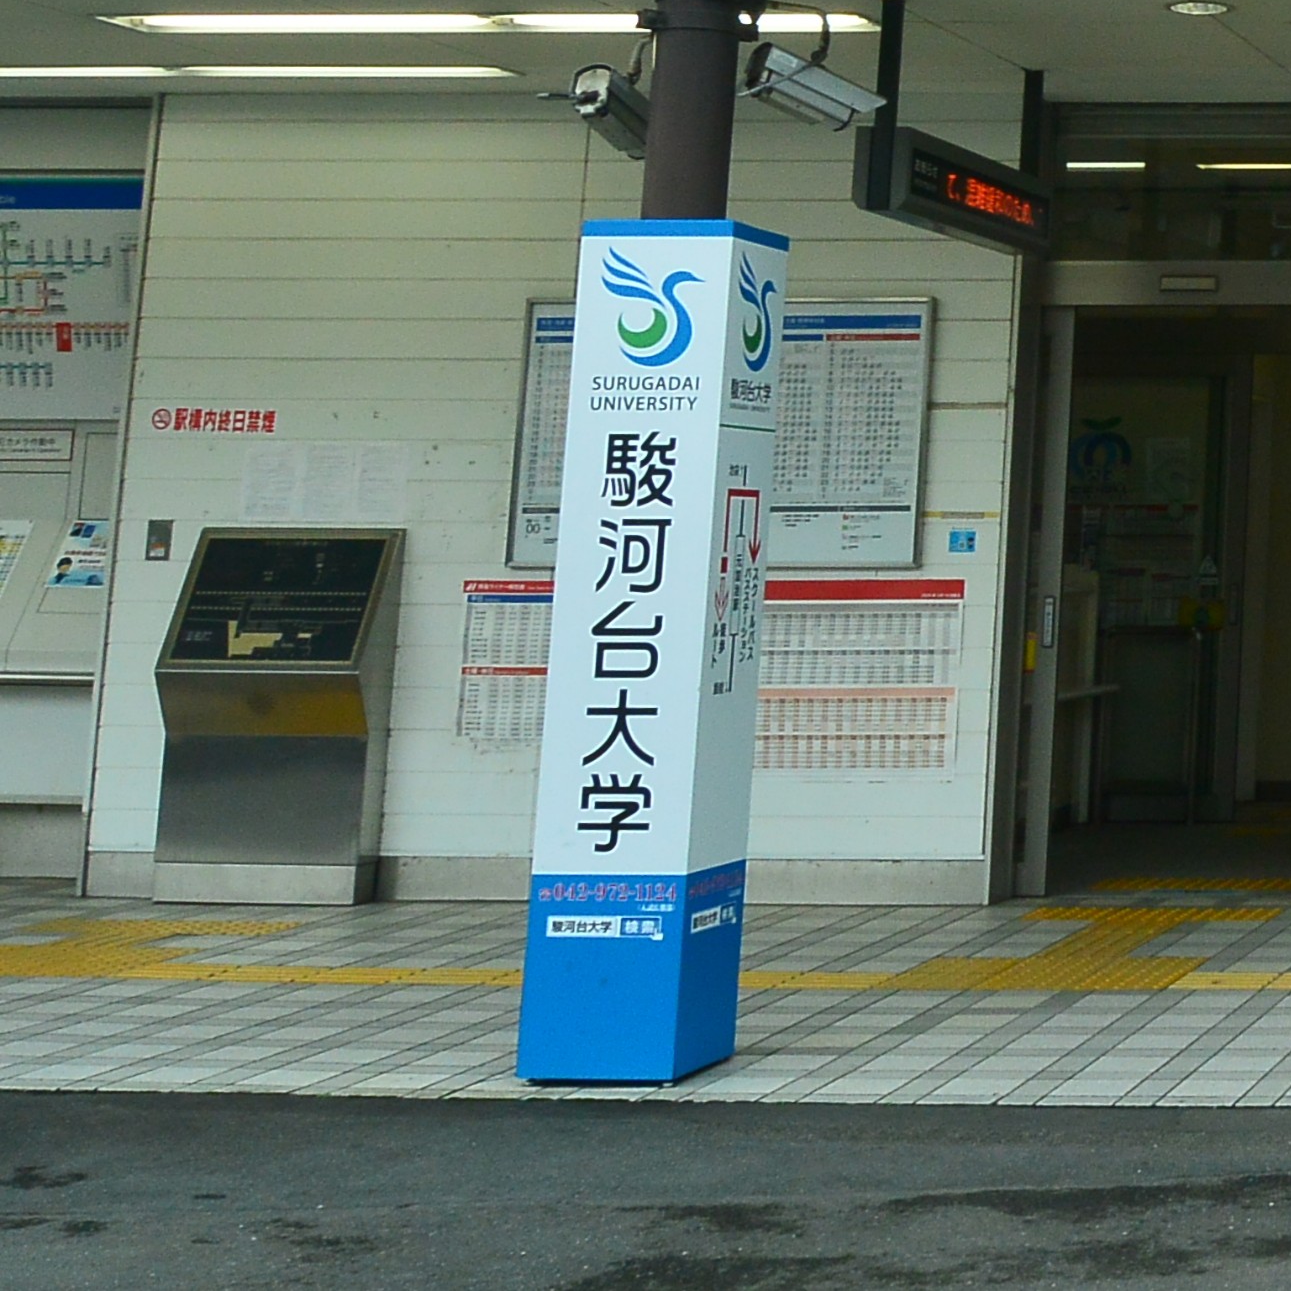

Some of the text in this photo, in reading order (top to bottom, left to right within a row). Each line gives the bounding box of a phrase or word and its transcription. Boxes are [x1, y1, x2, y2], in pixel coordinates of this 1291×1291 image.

[591, 376, 701, 391] SURUGADAI
[589, 396, 698, 411] UNIVERSITY
[173, 408, 276, 433] 駅構内終日禁煙
[577, 431, 677, 852] 駿河台大学
[554, 883, 677, 902] 042-972-1124
[551, 920, 612, 934] 駿河台大学
